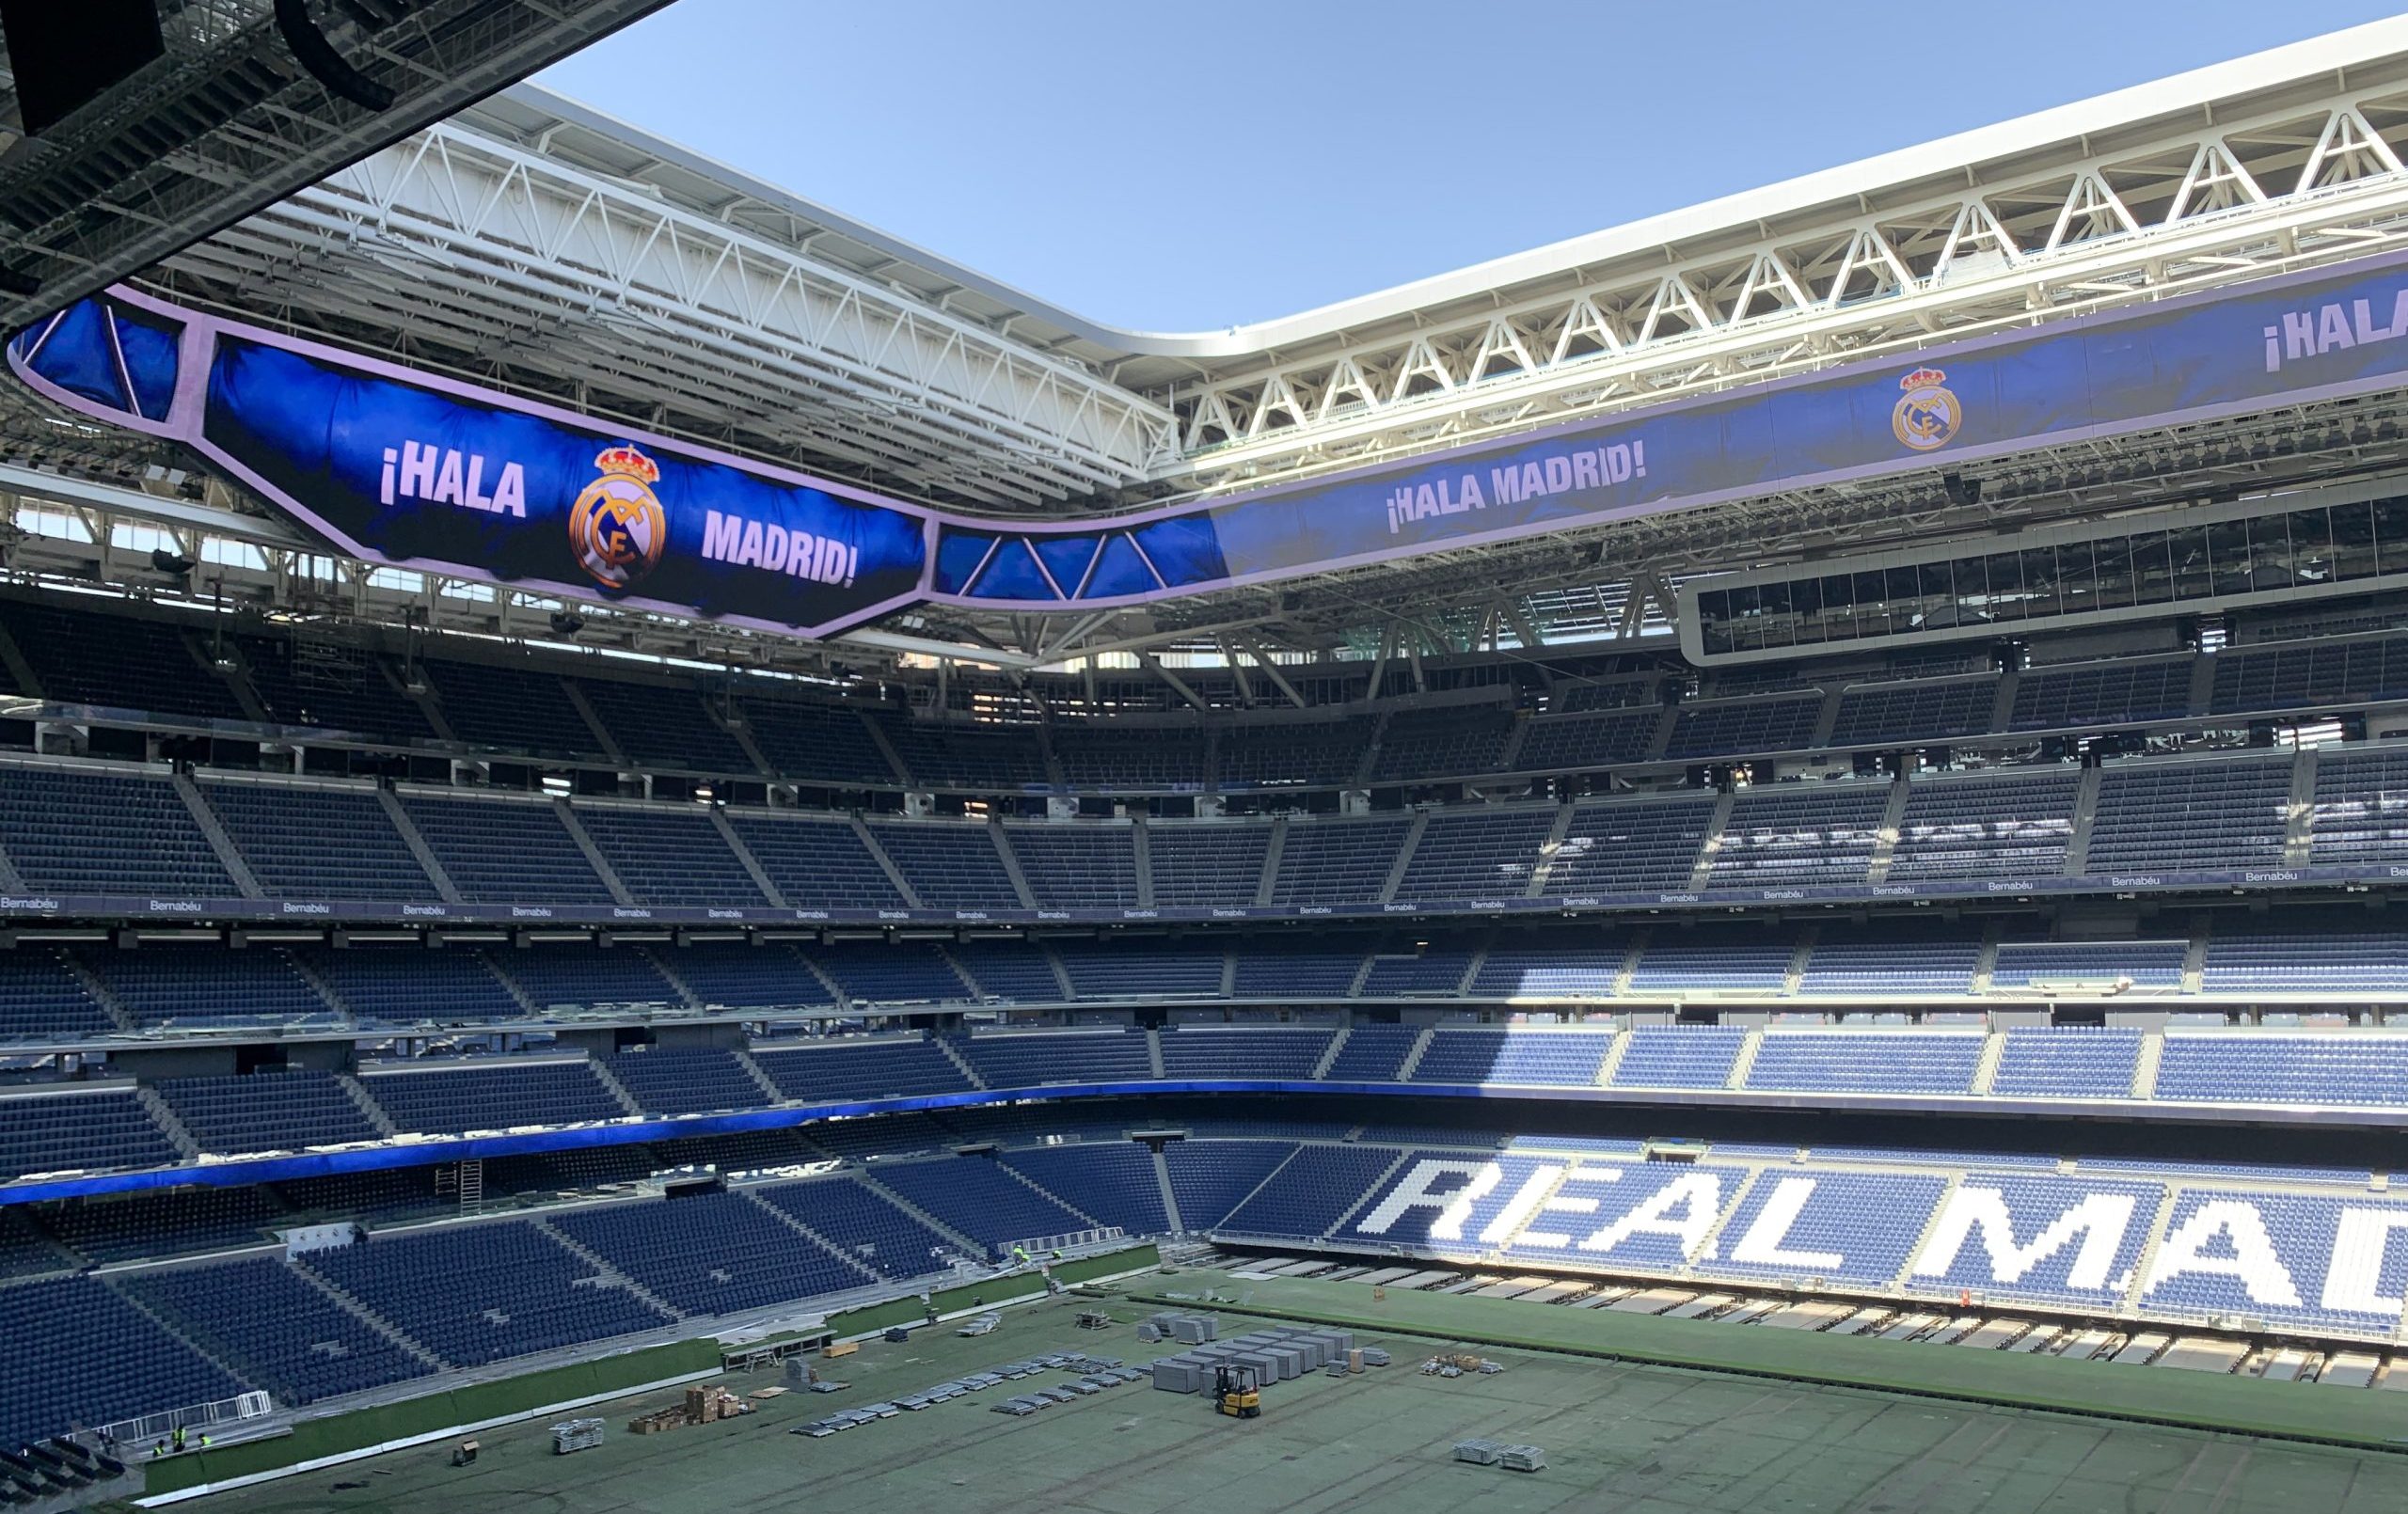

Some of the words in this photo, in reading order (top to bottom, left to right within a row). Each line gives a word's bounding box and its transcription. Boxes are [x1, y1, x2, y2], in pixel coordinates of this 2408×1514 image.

[1386, 474, 1486, 534] ¡HALA
[1492, 440, 1646, 506] MADRID!
[380, 439, 526, 518] ¡HALA
[701, 510, 859, 589] MADRID!
[2112, 875, 2161, 887] Bernabéu
[2245, 870, 2298, 882] Bernabéu
[1872, 885, 1915, 895] Bernabéu
[1988, 880, 2034, 891] Bernabéu
[1764, 890, 1804, 899] Bernabéu
[0, 897, 58, 909] Bernabéu
[150, 900, 201, 912] Bernabéu
[283, 902, 329, 914] Bernabéu
[403, 905, 446, 917] Bernabéu
[512, 907, 551, 918] Bernabéu
[1356, 1159, 1844, 1269] REAL
